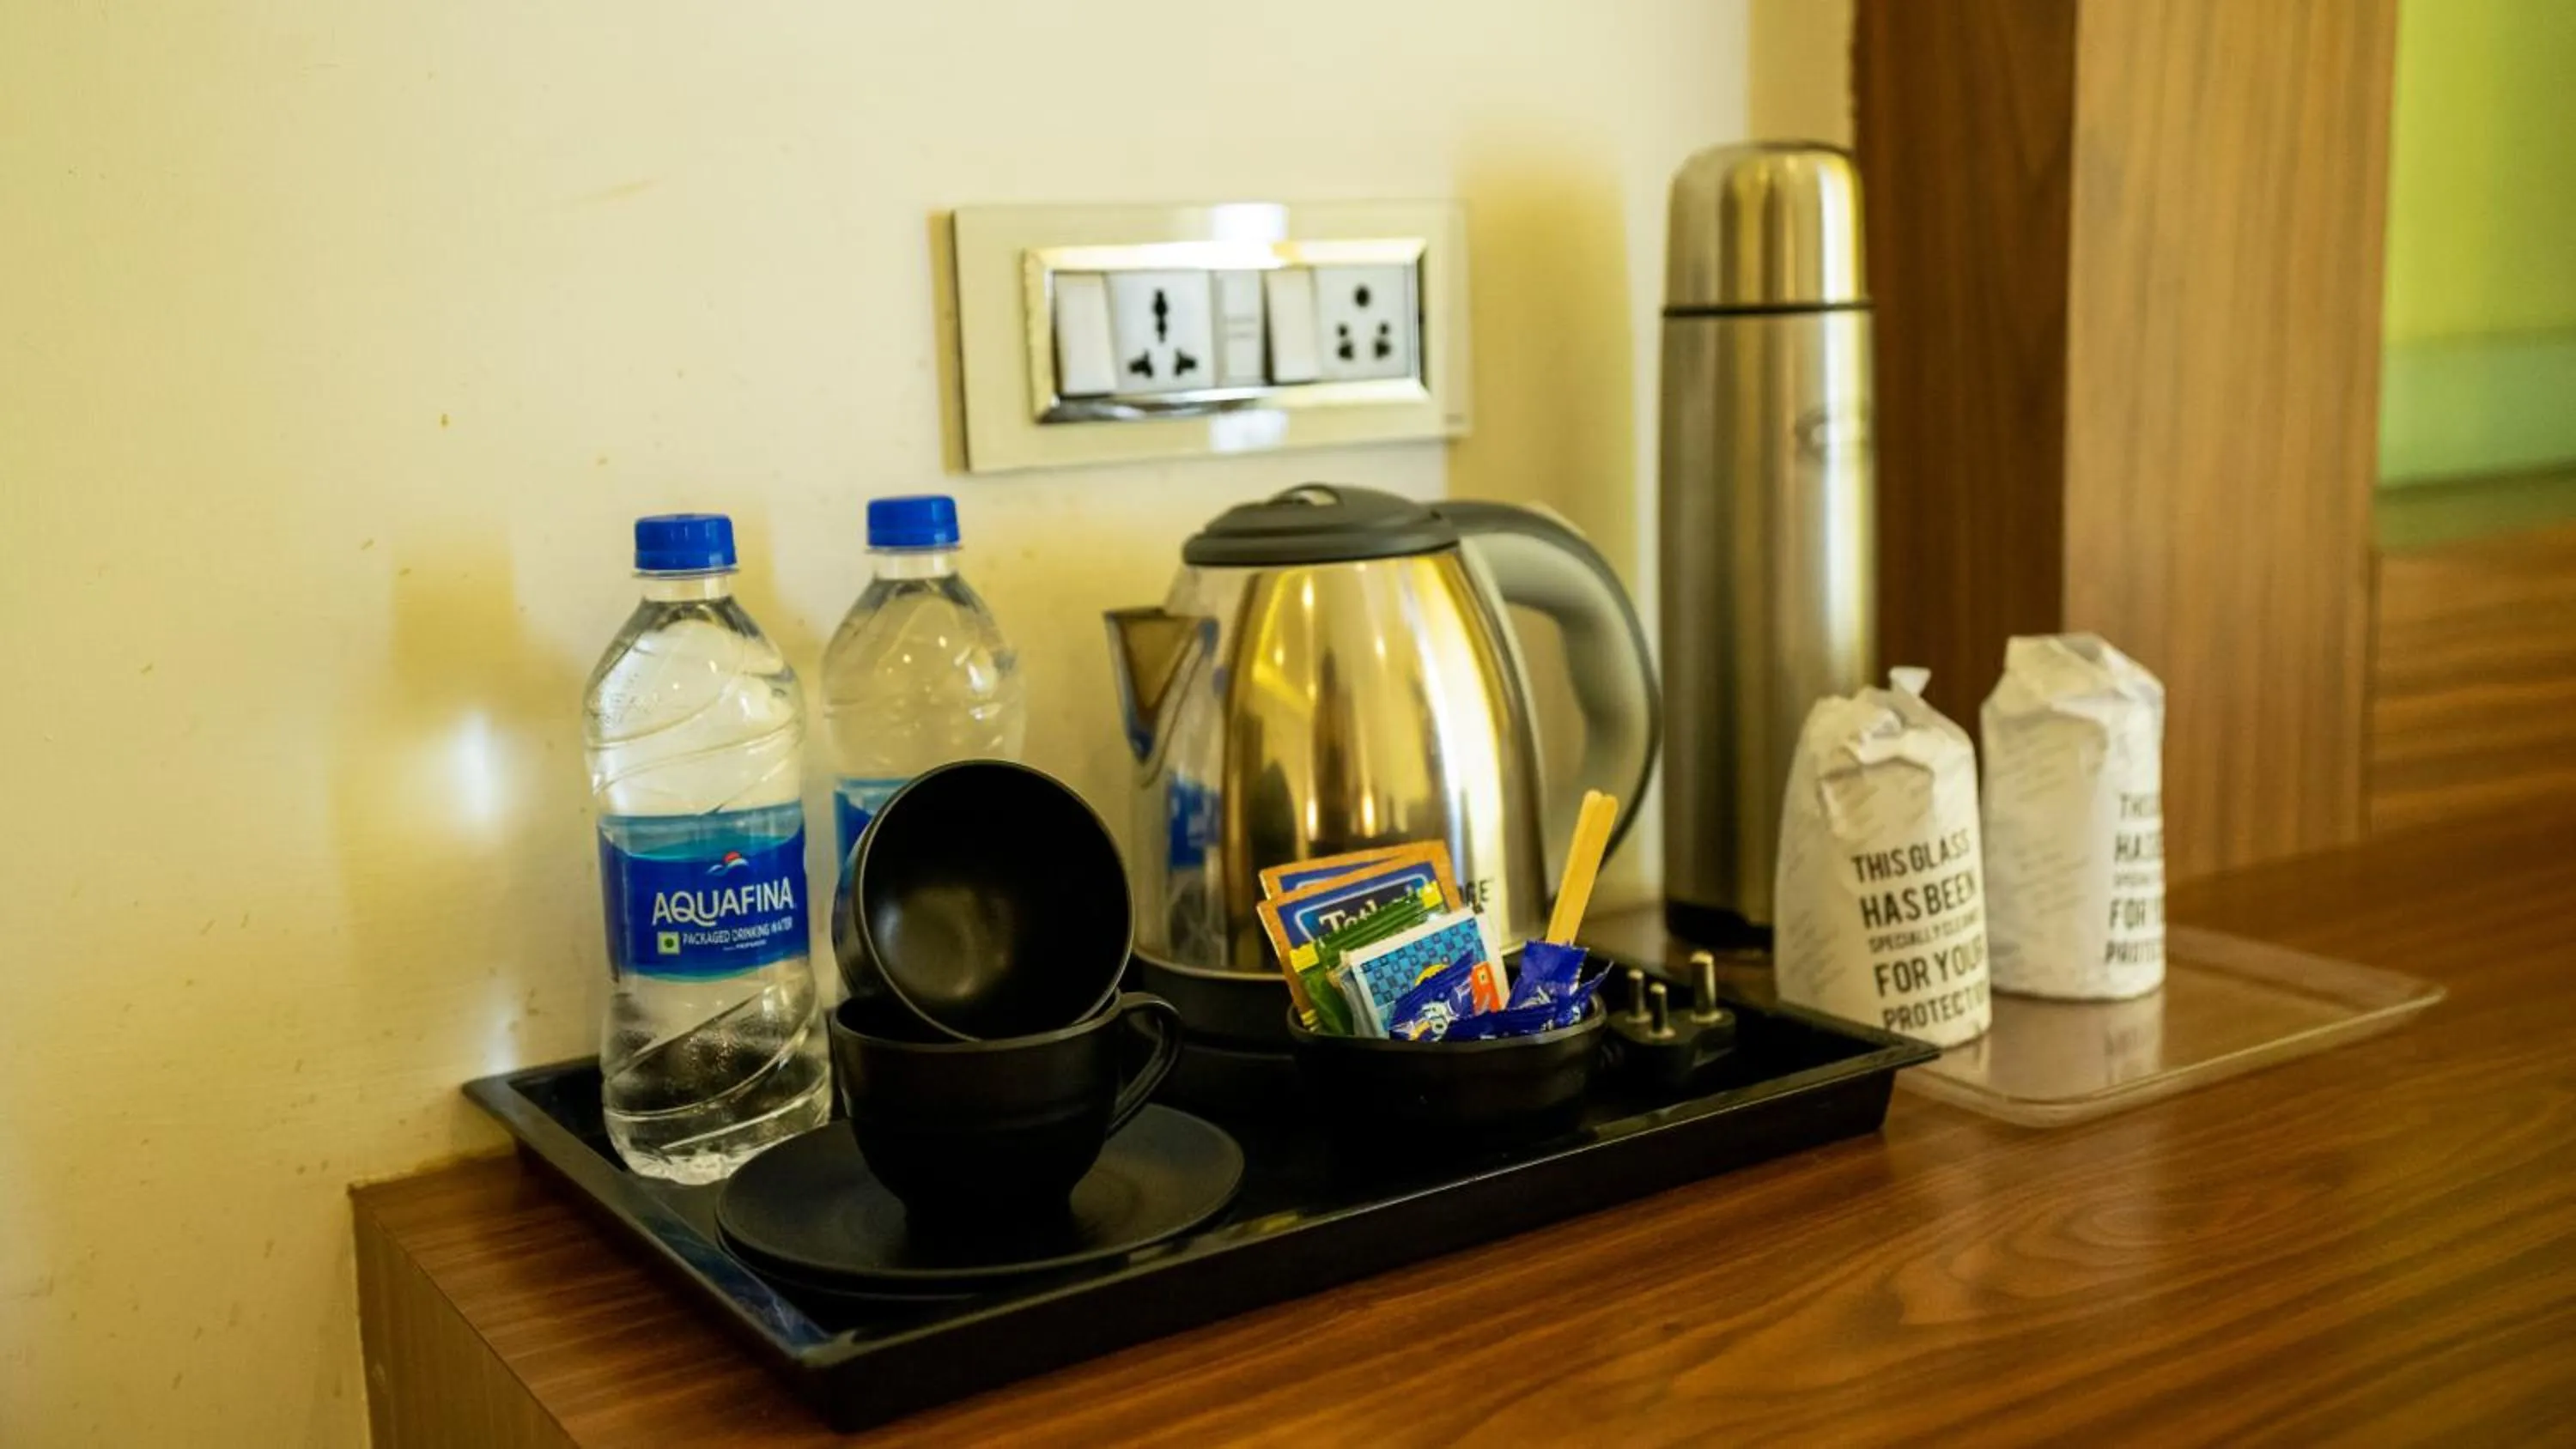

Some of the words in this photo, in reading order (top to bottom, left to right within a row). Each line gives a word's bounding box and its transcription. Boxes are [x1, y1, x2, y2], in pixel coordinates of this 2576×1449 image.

[1851, 848, 1907, 883] THIS
[1909, 828, 1970, 872] GLASS
[652, 876, 794, 926] AQUAFINA
[1859, 887, 1922, 930] HAS
[1923, 869, 1976, 916] BEEN
[683, 930, 730, 946] PACKAGED
[731, 923, 770, 943] DRINKING
[1874, 956, 1931, 998] FOR
